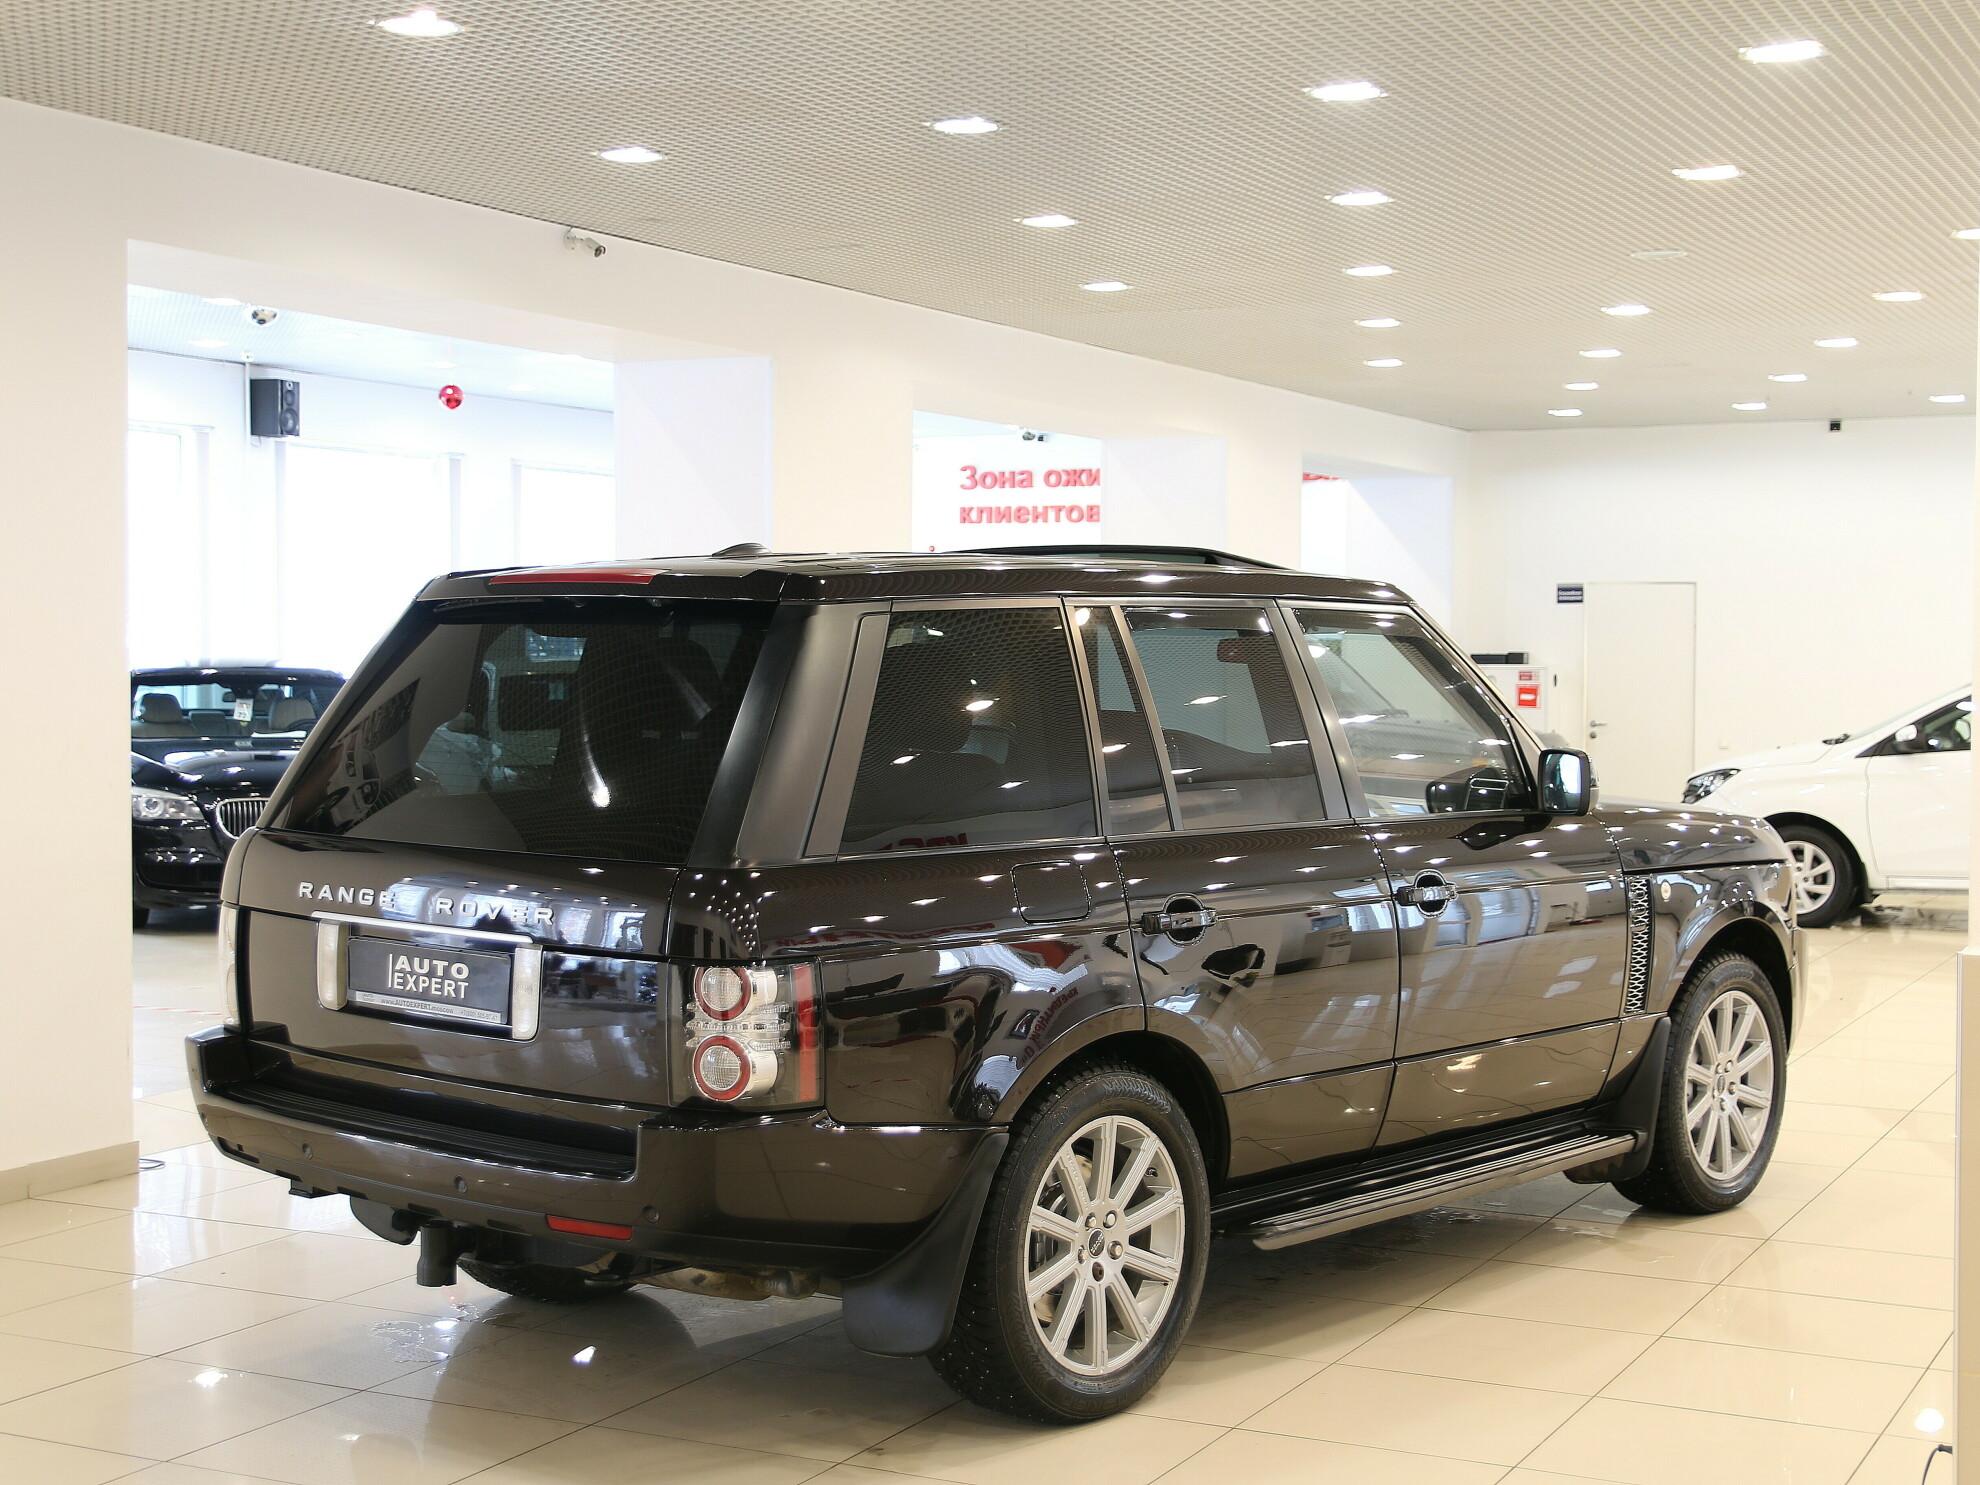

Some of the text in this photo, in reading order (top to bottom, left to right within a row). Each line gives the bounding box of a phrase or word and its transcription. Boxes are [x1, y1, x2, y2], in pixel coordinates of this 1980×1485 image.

[959, 464, 1034, 491] Зона
[959, 504, 1101, 524] клиентов
[298, 881, 554, 926] RANGE ROVER
[395, 955, 469, 979] AUTO
[393, 972, 469, 999] EXPERT
